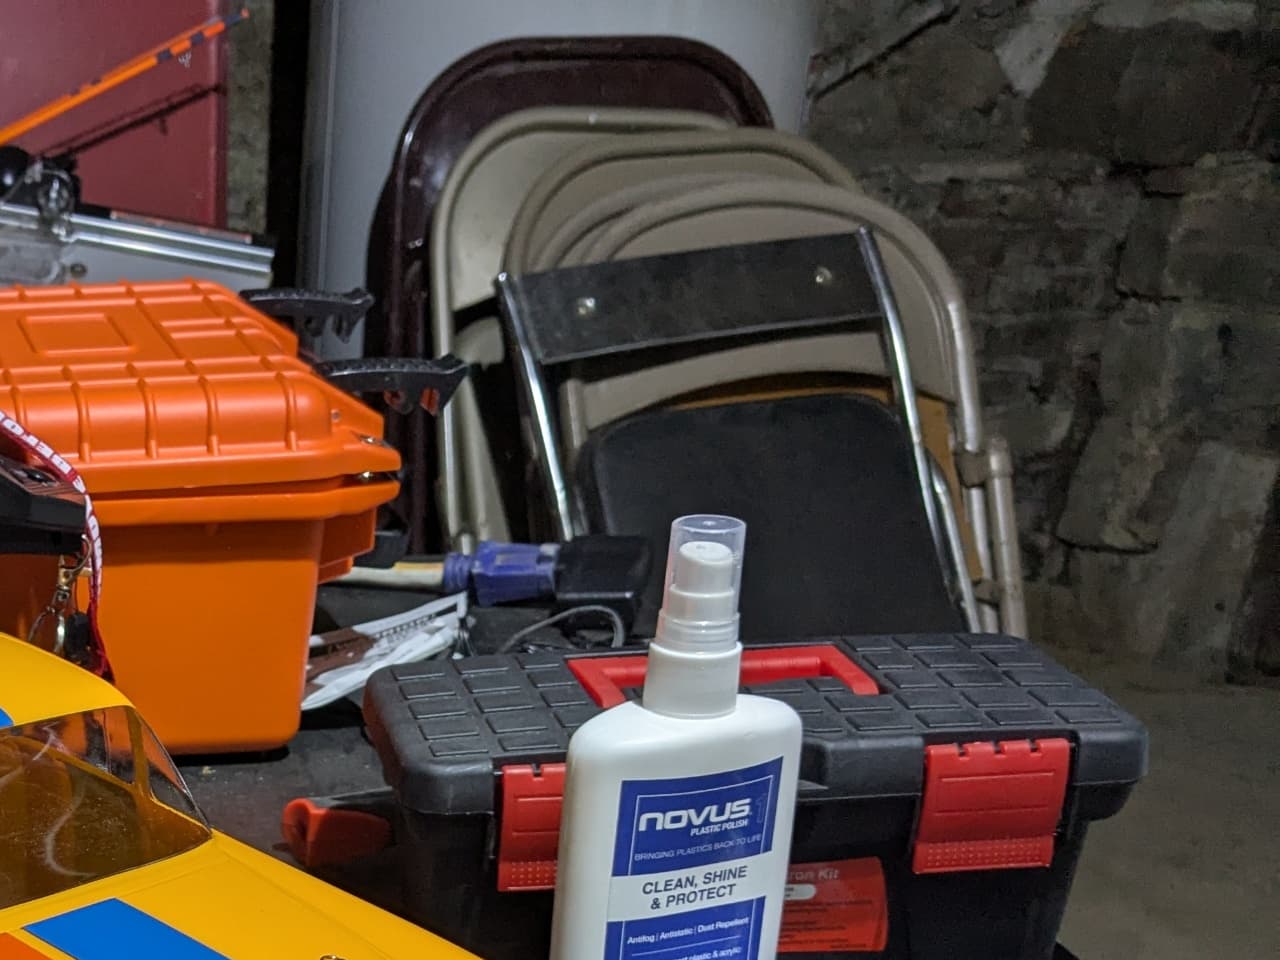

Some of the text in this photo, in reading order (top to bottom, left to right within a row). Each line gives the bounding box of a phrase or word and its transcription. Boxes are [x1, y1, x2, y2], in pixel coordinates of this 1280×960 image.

[690, 818, 748, 837] PLASTIC POLISH
[634, 833, 762, 862] BRINGING PLASTICS BACK TO LIFE
[642, 865, 748, 895] CLEAN, SHINE
[818, 868, 839, 880] Kit
[650, 883, 737, 910] & PROTECT
[627, 917, 749, 945] Antifog Antistatic Dust Repellent
[712, 950, 718, 958] &
[719, 946, 742, 958] acrylic
